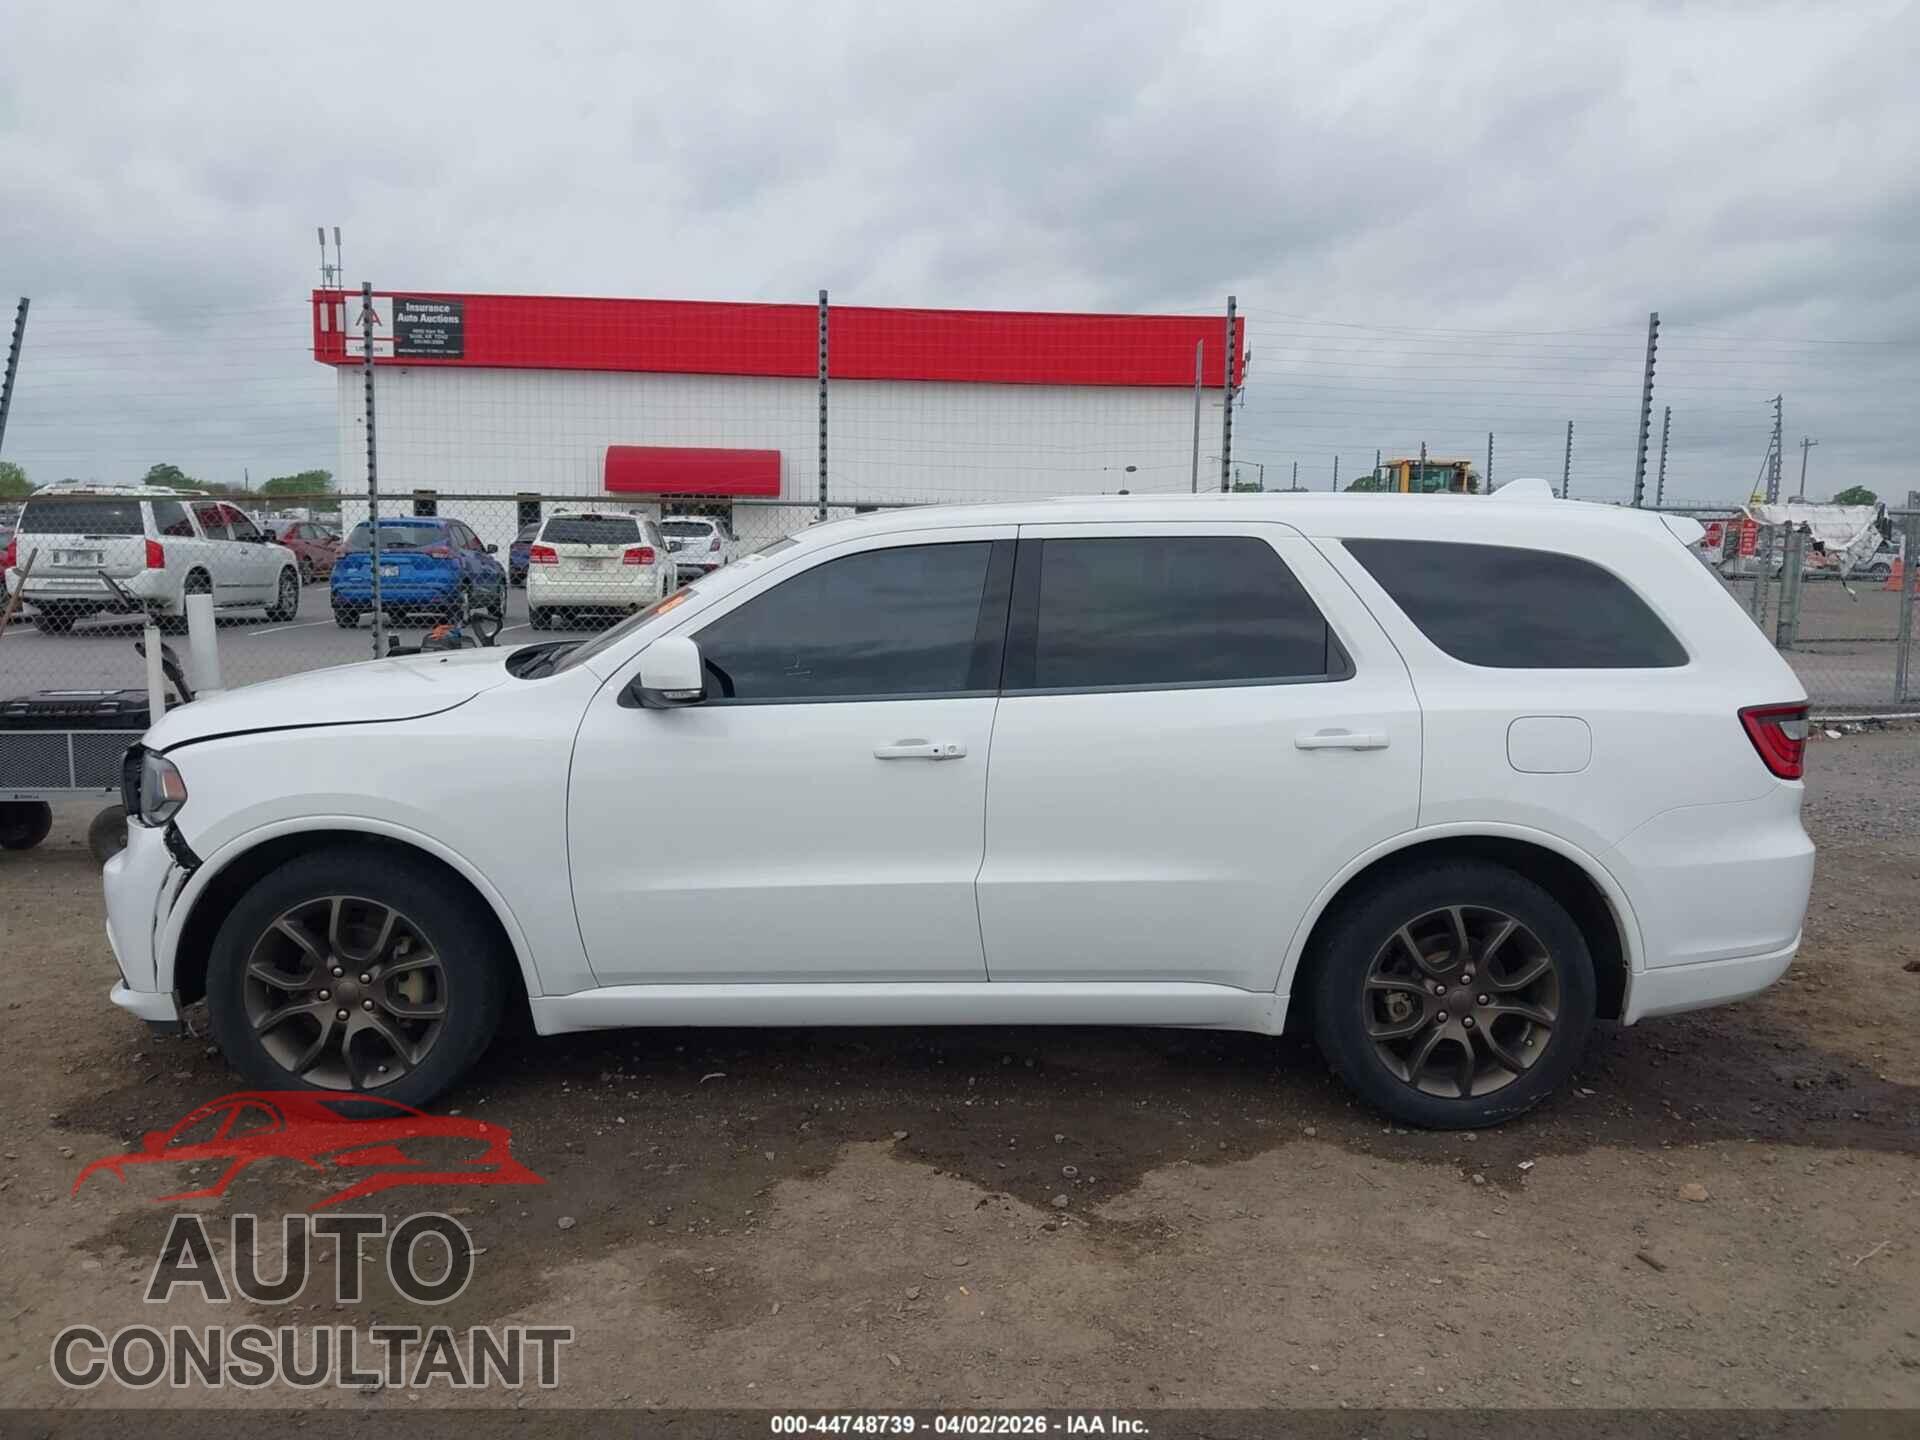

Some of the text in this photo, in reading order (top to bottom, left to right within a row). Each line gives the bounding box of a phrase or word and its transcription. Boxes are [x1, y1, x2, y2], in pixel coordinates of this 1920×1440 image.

[406, 302, 450, 312] Insurance
[397, 313, 460, 323] Auto Auctions
